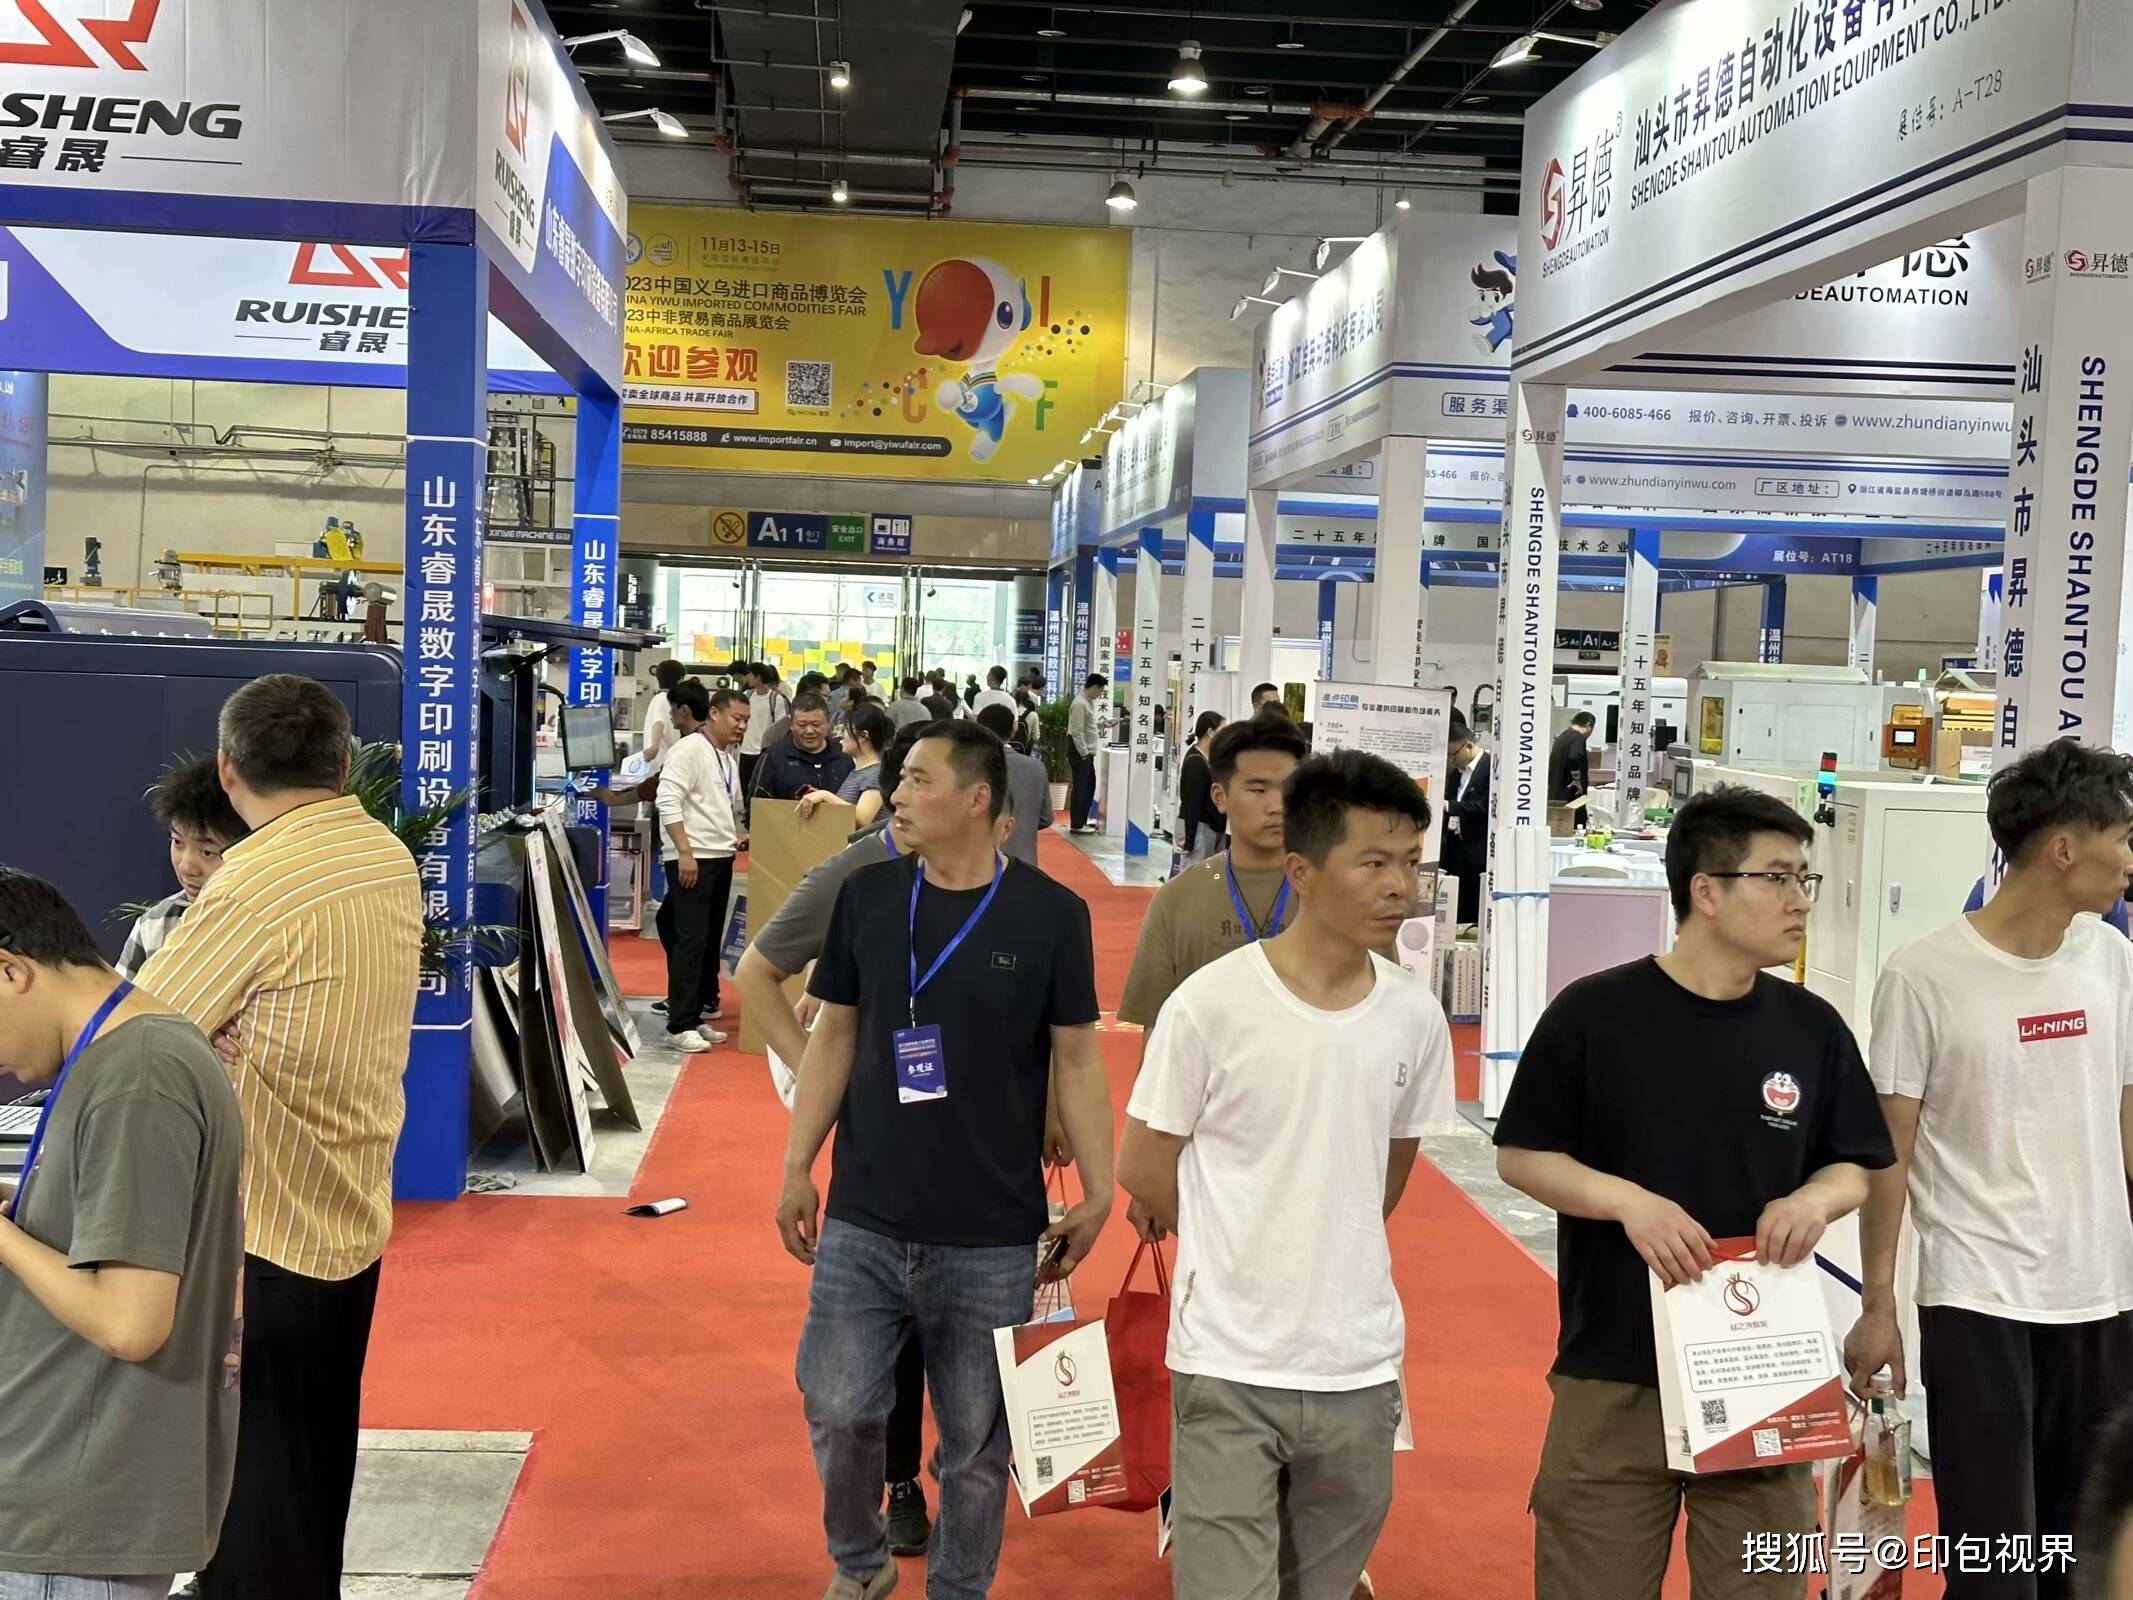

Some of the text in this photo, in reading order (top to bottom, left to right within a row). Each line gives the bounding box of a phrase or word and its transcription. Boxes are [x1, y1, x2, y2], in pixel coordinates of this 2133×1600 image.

[1634, 0, 1916, 171] 汕头市昇德自动化设备有
[1952, 69, 2003, 113] A-T28
[1631, 160, 1678, 210] SHENGDE
[1680, 131, 1736, 182] SHANTOU
[1737, 71, 1830, 150] AUTOMATION
[1832, 17, 1930, 97] EQUIPMENT
[495, 149, 535, 230] RUISHENG
[1565, 127, 1614, 241] 昇德
[508, 209, 522, 248] 睿晟
[701, 236, 781, 255] 11月13-15日
[1542, 226, 1610, 279] SHENGDEAUTOMATION
[2092, 253, 2129, 273] 昇德
[650, 295, 680, 307] YIWU
[682, 298, 742, 310] IMPORTED
[744, 301, 836, 315] COMMODITIES
[838, 304, 867, 317] FAIR
[625, 308, 790, 332] 23中非贸易商品展览会
[319, 330, 389, 354] 睿晟
[680, 328, 711, 337] TRADE
[712, 329, 734, 338] FAIR
[1583, 405, 1672, 421] 400-6085-466
[1688, 408, 1828, 428] 报价、咨询、开票、投诉
[650, 429, 708, 443] 85415888
[733, 432, 942, 451] www.importfair.cn import@yiwufair.com
[1536, 429, 1557, 442] 昇德
[2070, 356, 2107, 521] SHENGDE
[1589, 473, 1737, 492] www.zhundianyinwu.com
[832, 523, 864, 535] 安全出口
[838, 535, 855, 544] EXIT
[1292, 529, 1377, 544] 二十五年
[1526, 487, 1545, 578] SHENGDE
[1821, 551, 1854, 564] AT18
[2059, 530, 2094, 700] SHANTOU
[1520, 584, 1540, 677] SHANTOU
[1134, 617, 1155, 766] 二十五年知名品牌
[1625, 633, 1649, 802] 二十五年知名品牌
[417, 474, 458, 997] 山东睿晟数字印刷设备有限司
[1515, 682, 1537, 812] AUTOMATION
[2019, 1014, 2085, 1038] LI-NING
